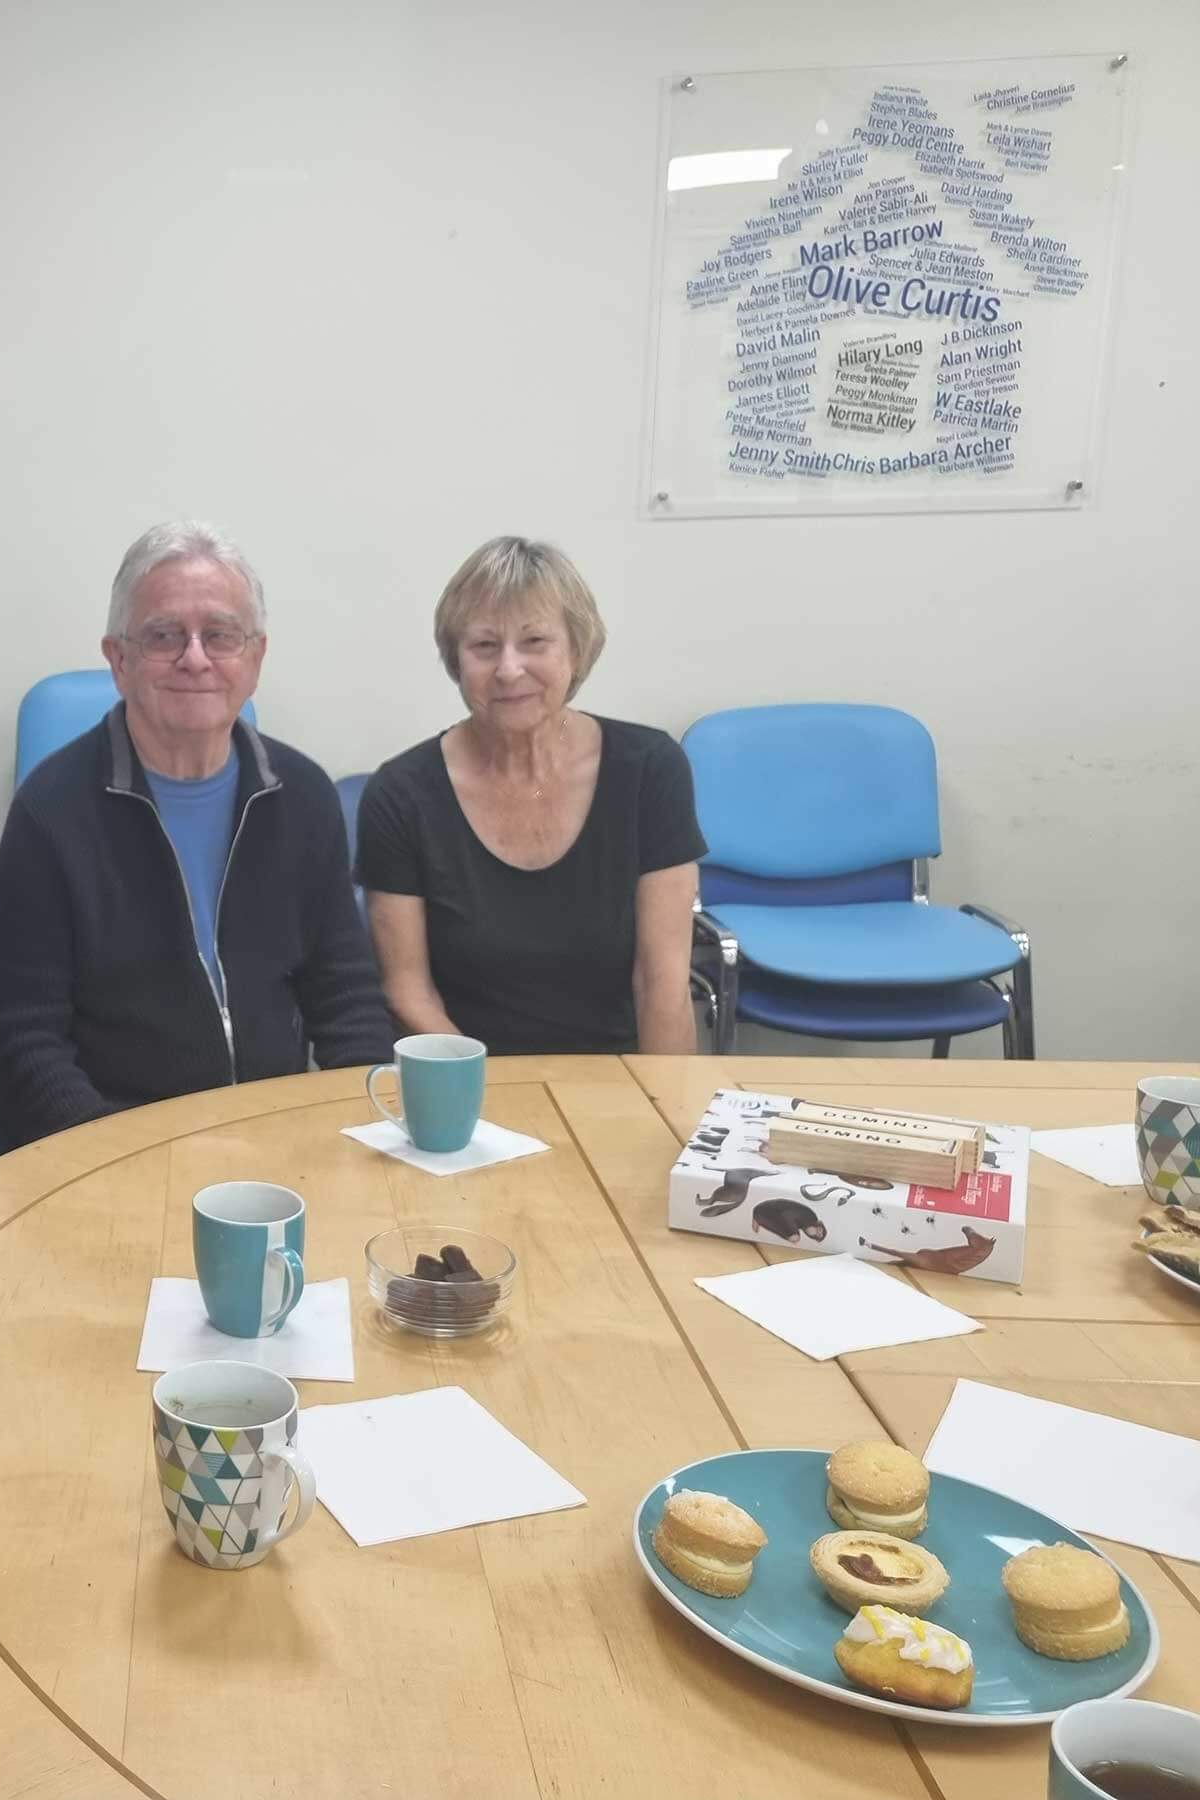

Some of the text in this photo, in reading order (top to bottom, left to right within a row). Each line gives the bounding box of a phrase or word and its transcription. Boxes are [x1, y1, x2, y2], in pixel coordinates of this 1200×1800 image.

[874, 92, 928, 107] Indiana White
[987, 94, 1028, 110] Christine
[1031, 84, 1075, 100] Cornelius
[870, 102, 938, 120] Stephen Blades
[868, 115, 955, 138] Irene Yeomans
[852, 128, 964, 154] Peggy Dodd Centre
[987, 133, 1052, 151] Leila Wishart
[802, 153, 869, 176] Shirley Fuller
[915, 151, 956, 166] Elizabeth
[809, 178, 815, 188] &
[833, 172, 841, 181] M
[920, 163, 1005, 184] Isabella Spotswood
[769, 185, 844, 209] Irene Wilson
[854, 183, 915, 204] Ann Parsons
[941, 181, 1013, 204] David Harding
[744, 205, 823, 230] Vivien Nineham
[838, 191, 928, 221] Valerie Sabir-Ali
[869, 216, 876, 226] &
[906, 203, 937, 218] Harvey
[968, 208, 998, 222] Susan
[1000, 211, 1035, 229] Wakely
[730, 220, 802, 247] Samantha Ball
[800, 234, 857, 266] Mark
[863, 220, 944, 253] Barrow
[990, 230, 1067, 252] Brenda Wilton
[701, 260, 721, 274] Joy
[724, 248, 772, 268] Rodgers
[869, 252, 912, 271] Spencer
[914, 260, 923, 272] &
[925, 262, 952, 276] Jean
[954, 266, 994, 281] Meston
[910, 247, 937, 262] Julia
[939, 251, 985, 268] Edwards
[1006, 248, 1082, 268] Sheila Gardiner
[686, 275, 725, 291] Pauline
[728, 268, 759, 283] Green
[750, 282, 779, 297] Anne
[782, 274, 808, 290] Flint
[736, 296, 780, 313] Adelaide
[808, 264, 1001, 322] Olive Curtis
[776, 321, 782, 332] &
[785, 314, 818, 330] Pamela
[940, 320, 1022, 346] J B Dickinson
[736, 328, 821, 358] David Malin
[838, 348, 880, 368] Hilary
[885, 339, 923, 358] Long
[940, 351, 972, 368] Alan
[975, 338, 1022, 360] Wright
[740, 348, 817, 374] Jenny Diamond
[728, 364, 817, 392] Dorothy Wilmot
[836, 370, 910, 392] Teresa Woolley
[936, 360, 1021, 386] Sam Priestman
[736, 393, 774, 409] James
[776, 383, 810, 400] Elliott
[835, 384, 866, 400] Peggy
[868, 389, 918, 406] Monkman
[936, 391, 1022, 419] W Eastlake
[726, 409, 807, 432] Peter Mansfield
[826, 404, 873, 425] Norma
[876, 411, 916, 433] Kitley
[933, 409, 978, 428] Patricia
[980, 416, 1019, 434] Martin
[732, 423, 812, 447] Philip Norman
[730, 441, 780, 467] Jenny
[784, 448, 832, 472] Smith
[833, 452, 876, 474] Chris
[880, 436, 1012, 475] Barbara Archer
[976, 453, 1015, 467] Williams
[823, 1110, 929, 1131] DOMINO
[795, 1123, 902, 1146] DOMINO
